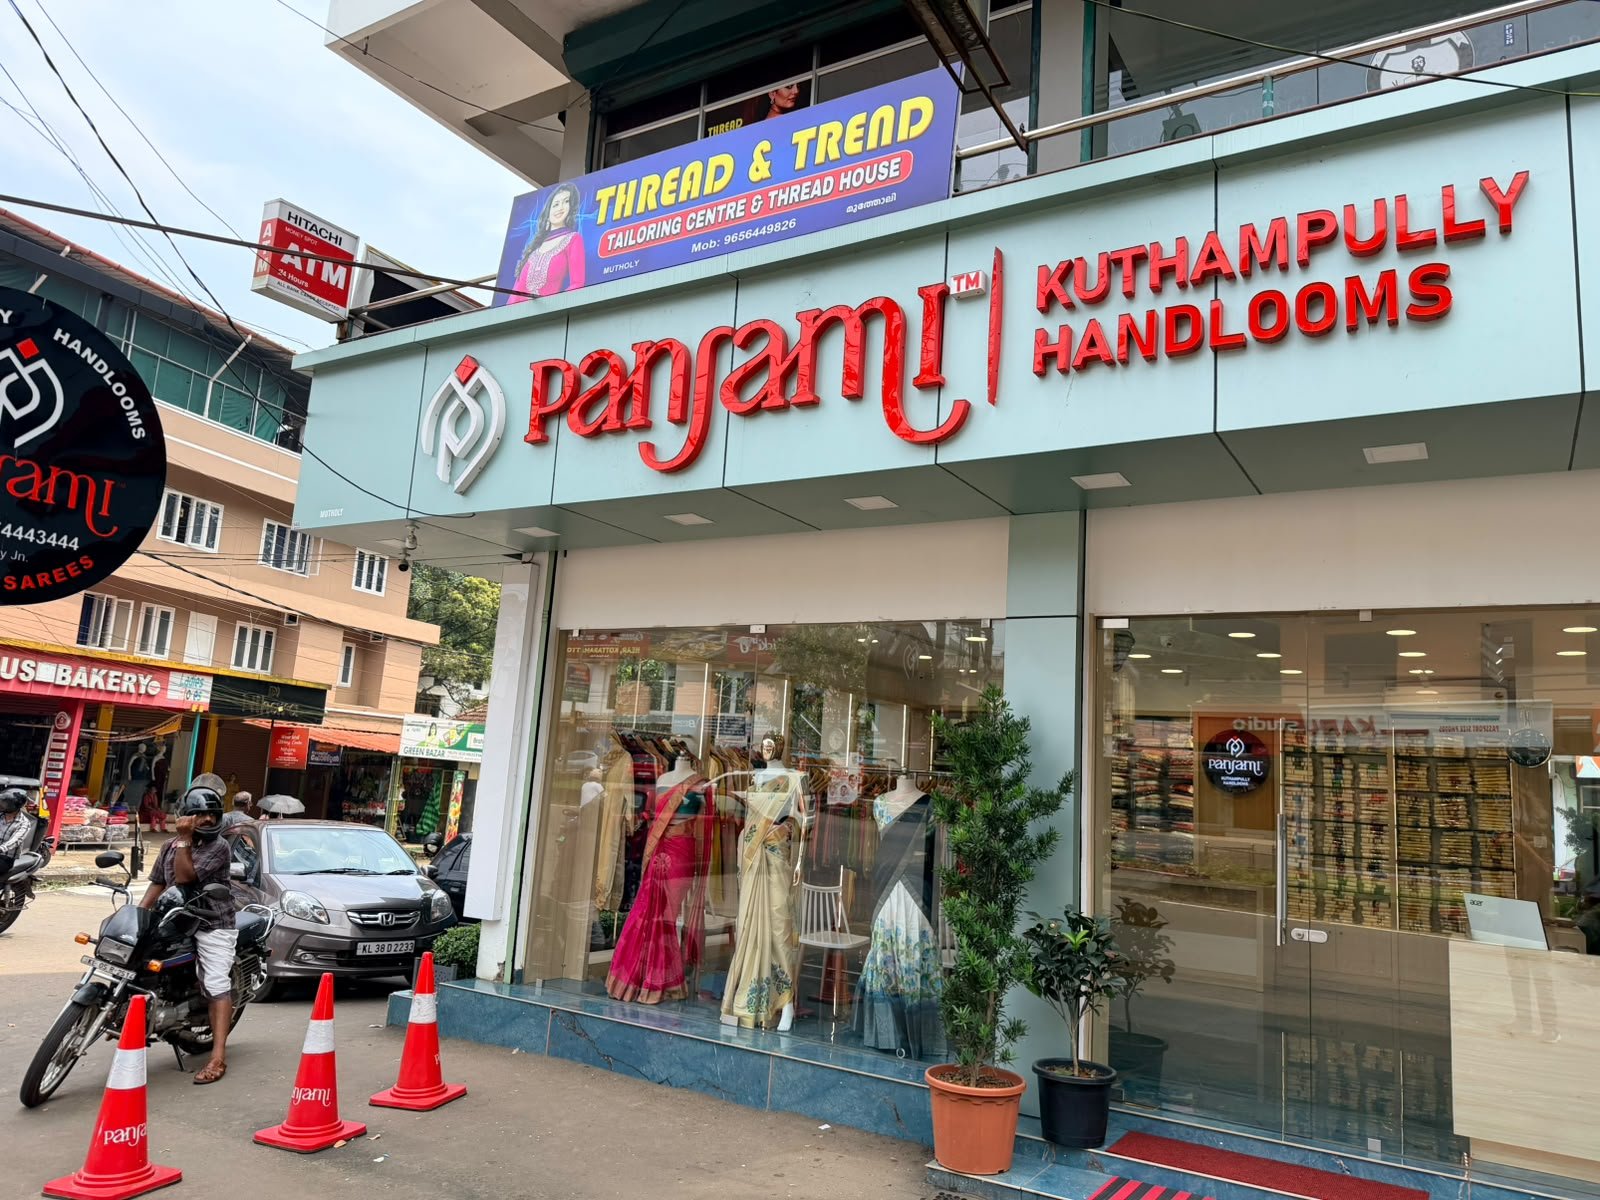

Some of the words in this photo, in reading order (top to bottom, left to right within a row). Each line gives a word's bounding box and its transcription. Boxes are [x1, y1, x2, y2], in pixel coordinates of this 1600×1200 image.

[1505, 23, 1513, 45] PUSH
[708, 118, 743, 138] THREAD
[595, 153, 735, 225] THREAD
[748, 139, 772, 183] &
[791, 96, 935, 171] TREND
[607, 216, 682, 251] TAILORING
[686, 198, 747, 231] CENTRE
[751, 194, 764, 214] &
[768, 175, 835, 209] THREAD
[839, 157, 901, 191] HOUSE
[285, 226, 304, 238] MONEY
[304, 235, 318, 246] SPOT
[287, 211, 343, 247] HITACHI
[691, 238, 720, 253] Mob:
[724, 218, 797, 245] 9656449826
[1036, 170, 1530, 315] KUTHAMPULLY
[278, 268, 286, 277] 24
[288, 273, 309, 288] Hours
[280, 242, 347, 290] ATM
[603, 259, 640, 275] MUTHOLY
[276, 281, 286, 289] ALL
[286, 284, 300, 294] BANK
[952, 272, 982, 291] TM
[1033, 262, 1453, 377] HANDLOOMS
[53, 328, 146, 439] HANDLOOMS
[0, 522, 80, 551] 4443444
[10, 550, 28, 562] Jn.
[3, 555, 95, 590] SAREES
[54, 663, 153, 695] BAKERY
[403, 746, 425, 756] GREEN
[425, 748, 446, 758] BAZAR
[1469, 899, 1484, 907] acer
[362, 944, 373, 954] KL
[374, 943, 386, 953] 38
[386, 943, 393, 953] D
[393, 942, 414, 952] 2233
